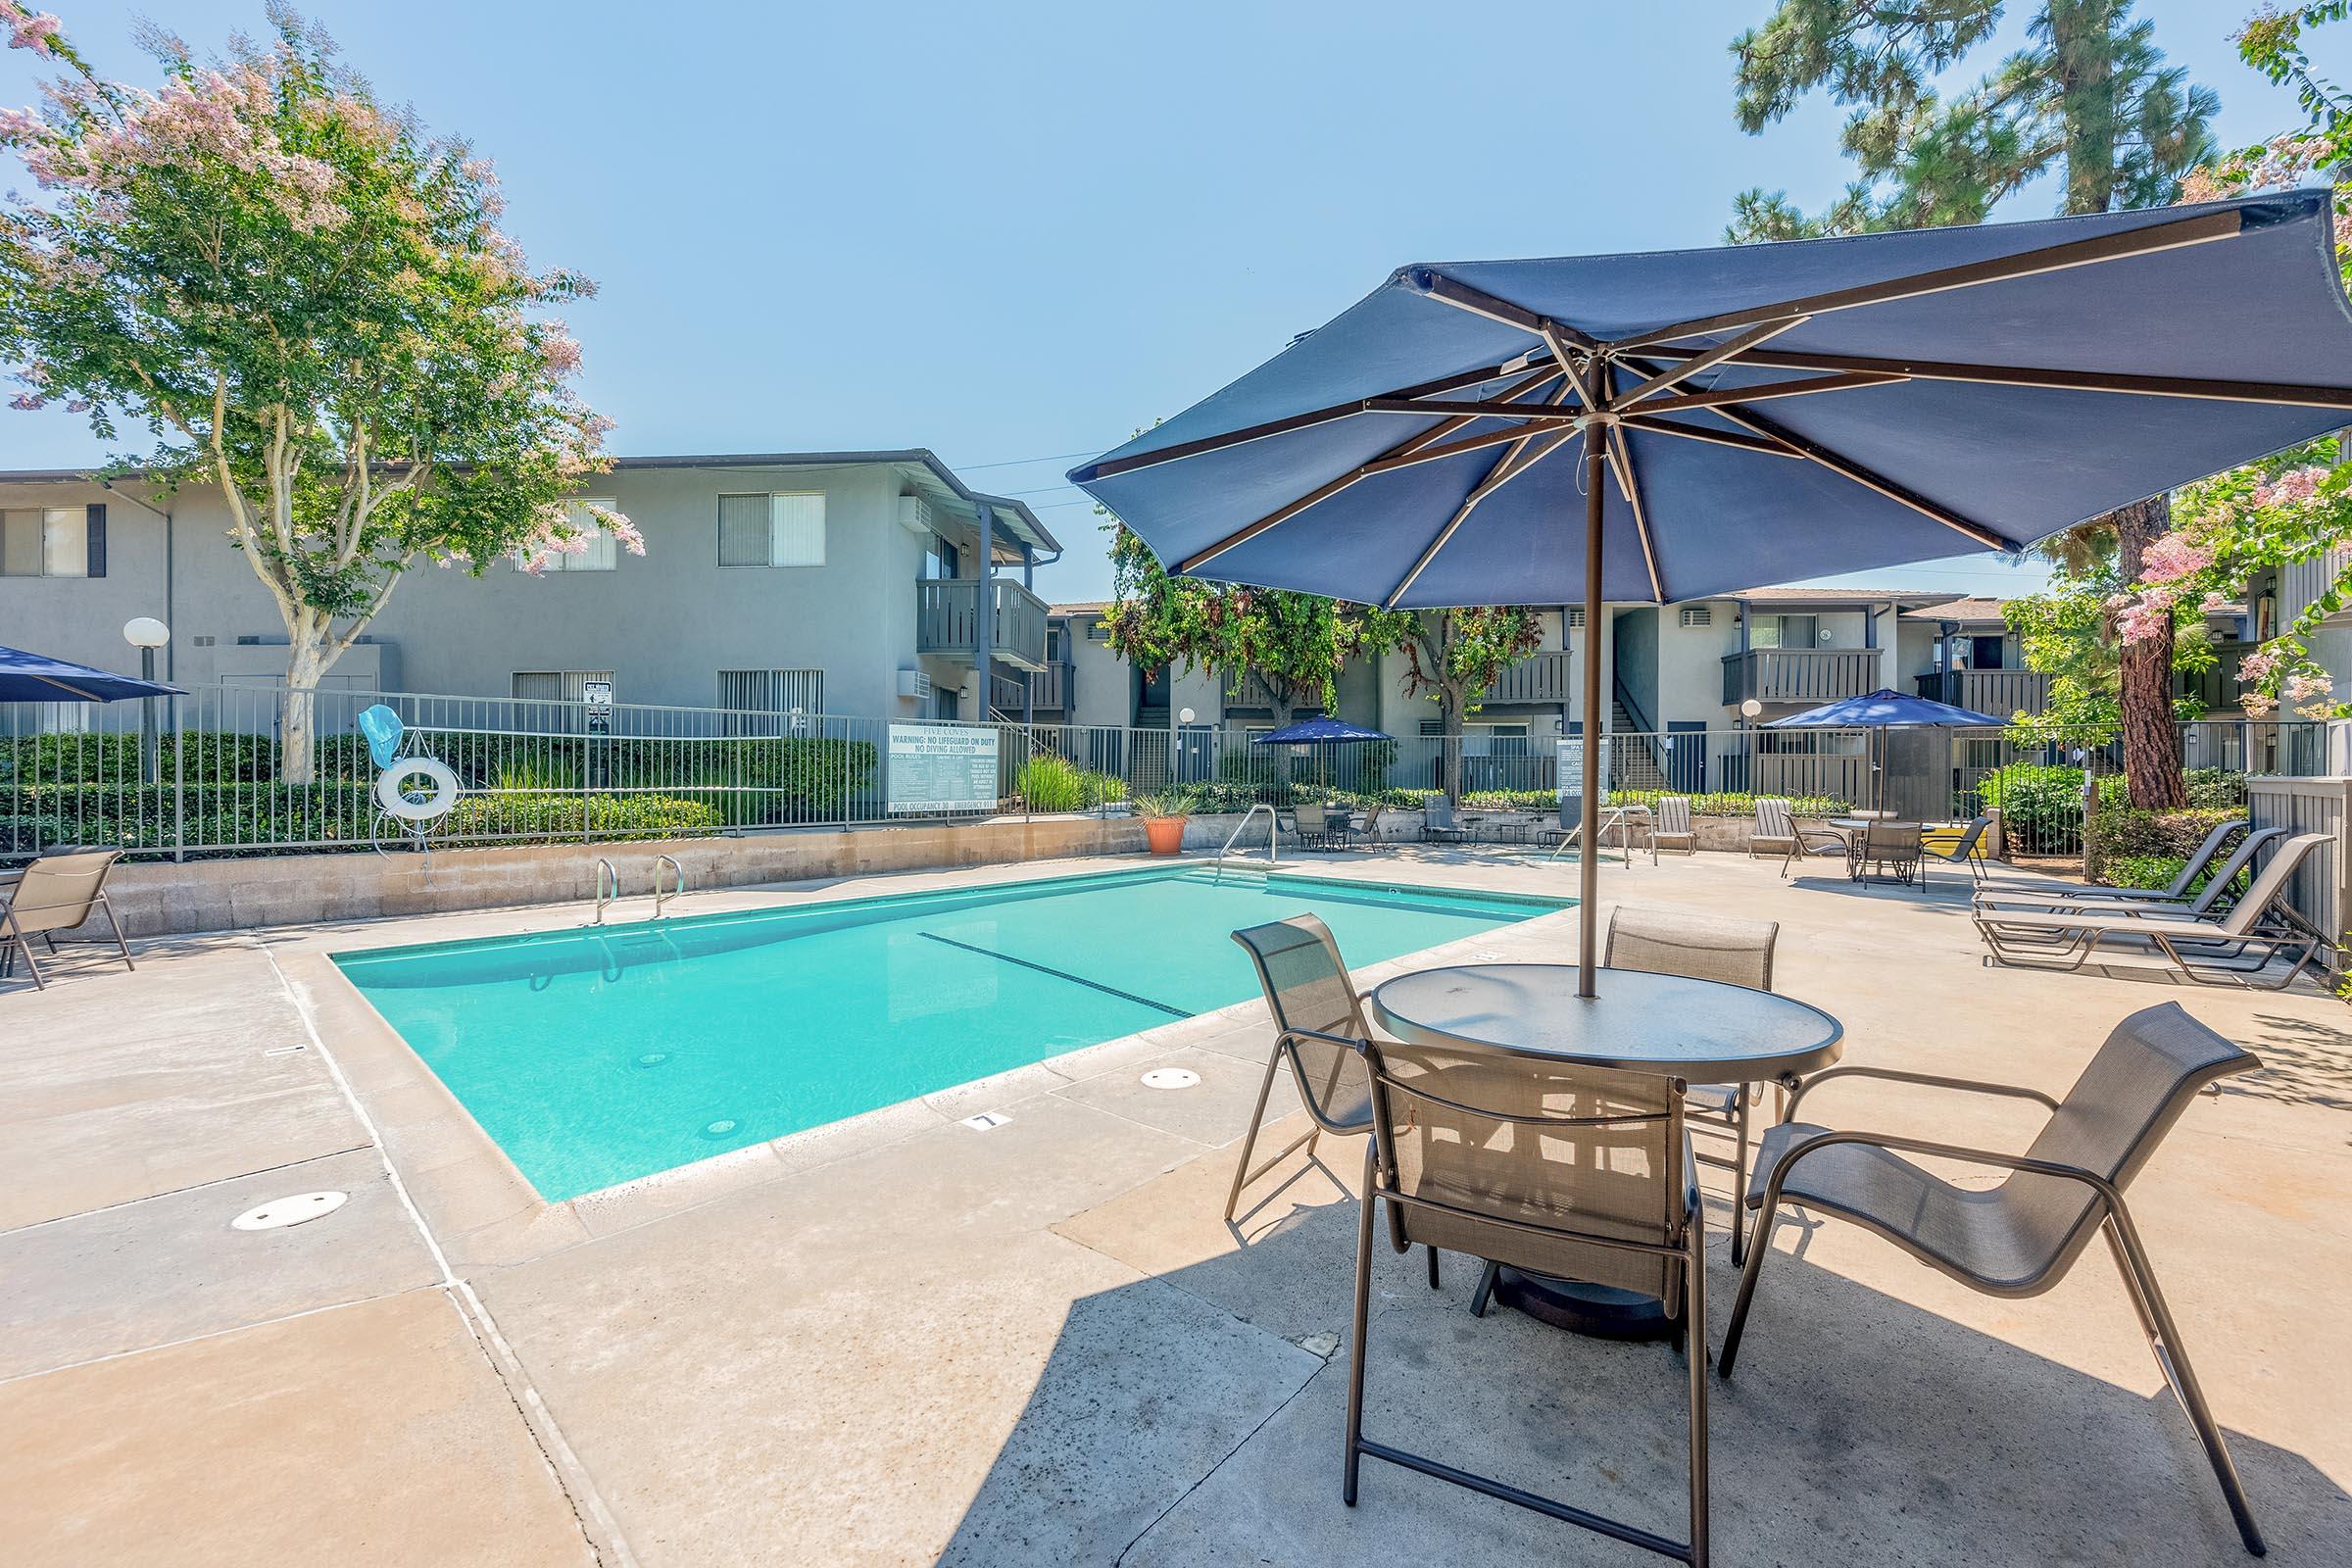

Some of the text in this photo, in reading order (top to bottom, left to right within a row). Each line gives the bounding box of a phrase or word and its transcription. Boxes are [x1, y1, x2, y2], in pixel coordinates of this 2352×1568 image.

[893, 735, 926, 744] WARNING:
[928, 736, 937, 745] NO
[939, 737, 969, 746] LIFEGUARD
[927, 745, 948, 754] DIVING
